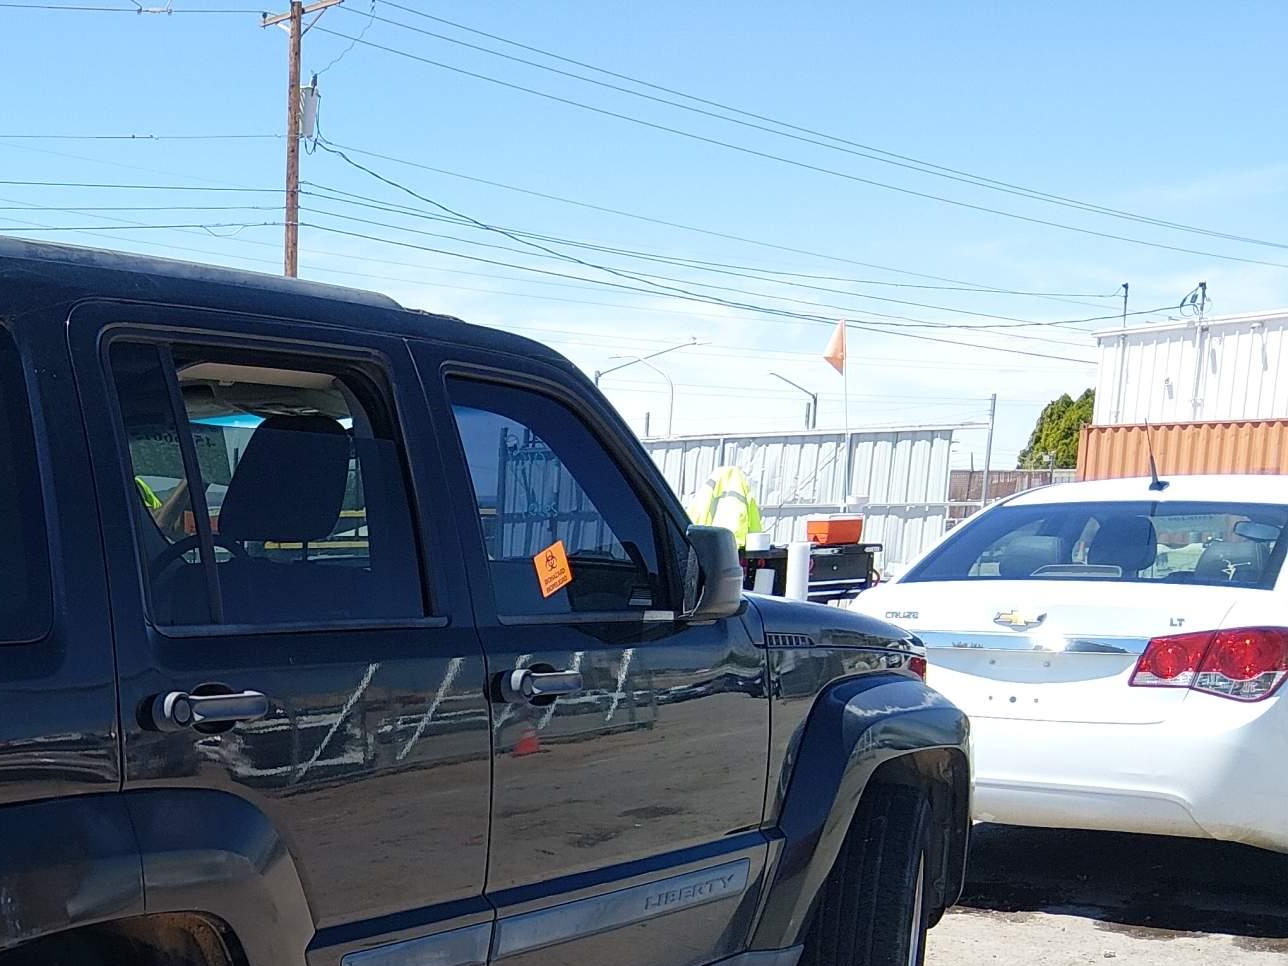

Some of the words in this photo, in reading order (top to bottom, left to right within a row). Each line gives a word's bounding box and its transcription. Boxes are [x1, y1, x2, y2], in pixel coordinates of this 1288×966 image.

[885, 611, 919, 619] CRUZE
[1169, 617, 1185, 627] LT
[644, 873, 735, 910] LIBERTY
